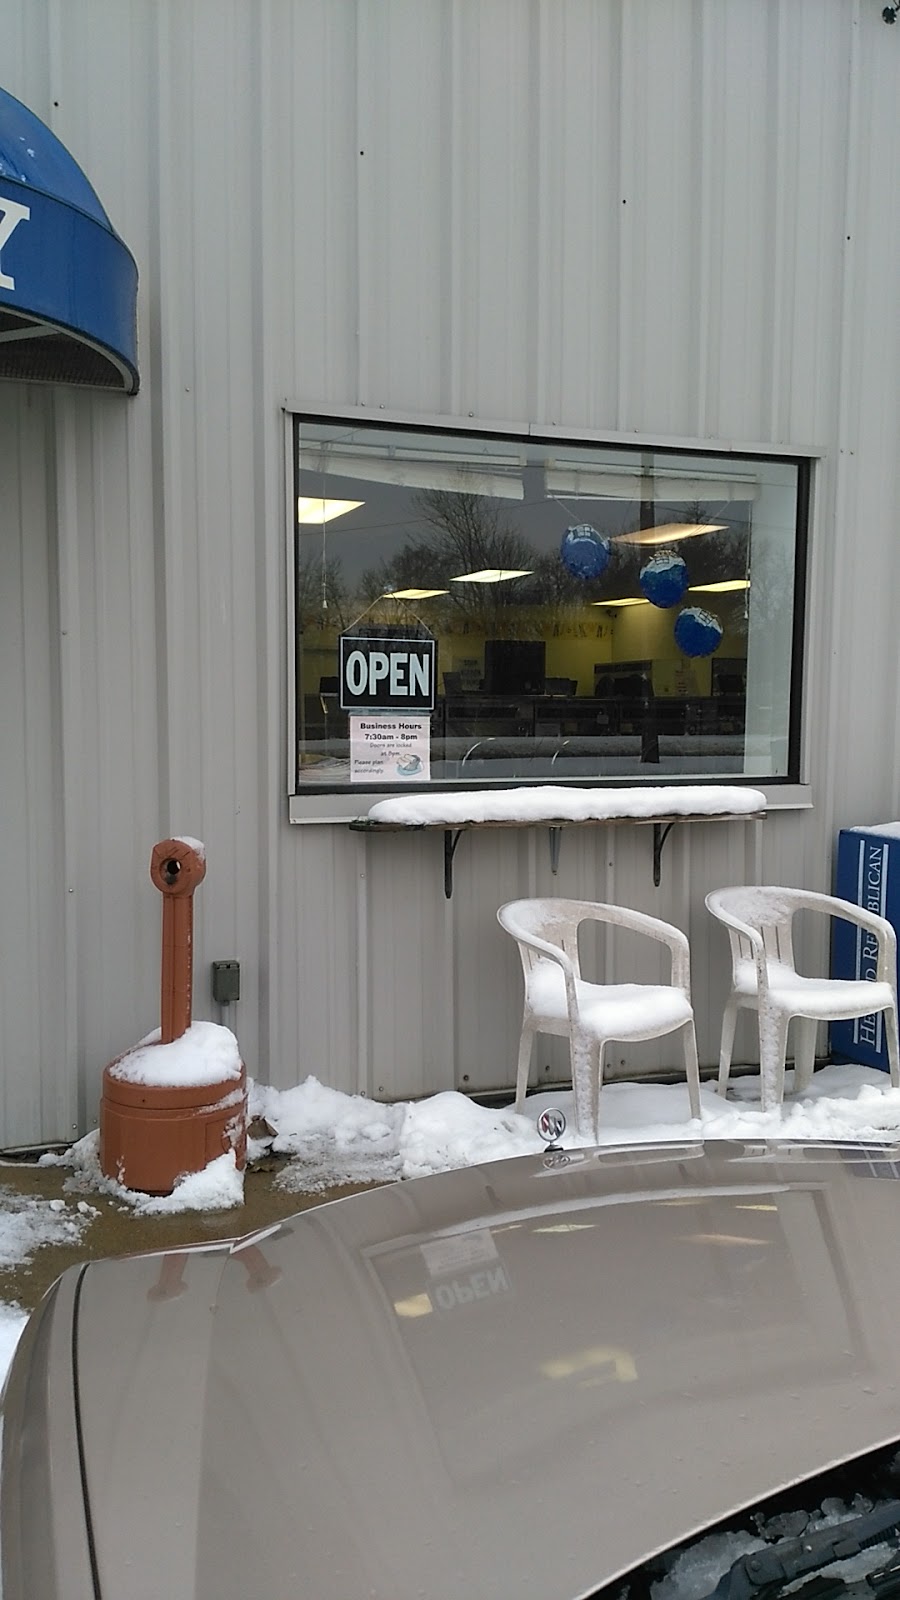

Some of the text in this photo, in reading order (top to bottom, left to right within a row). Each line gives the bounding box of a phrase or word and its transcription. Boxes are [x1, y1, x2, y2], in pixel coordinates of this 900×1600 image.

[346, 650, 430, 697] OPEN
[360, 722, 422, 730] Business Hours
[400, 733, 418, 741] 8pm
